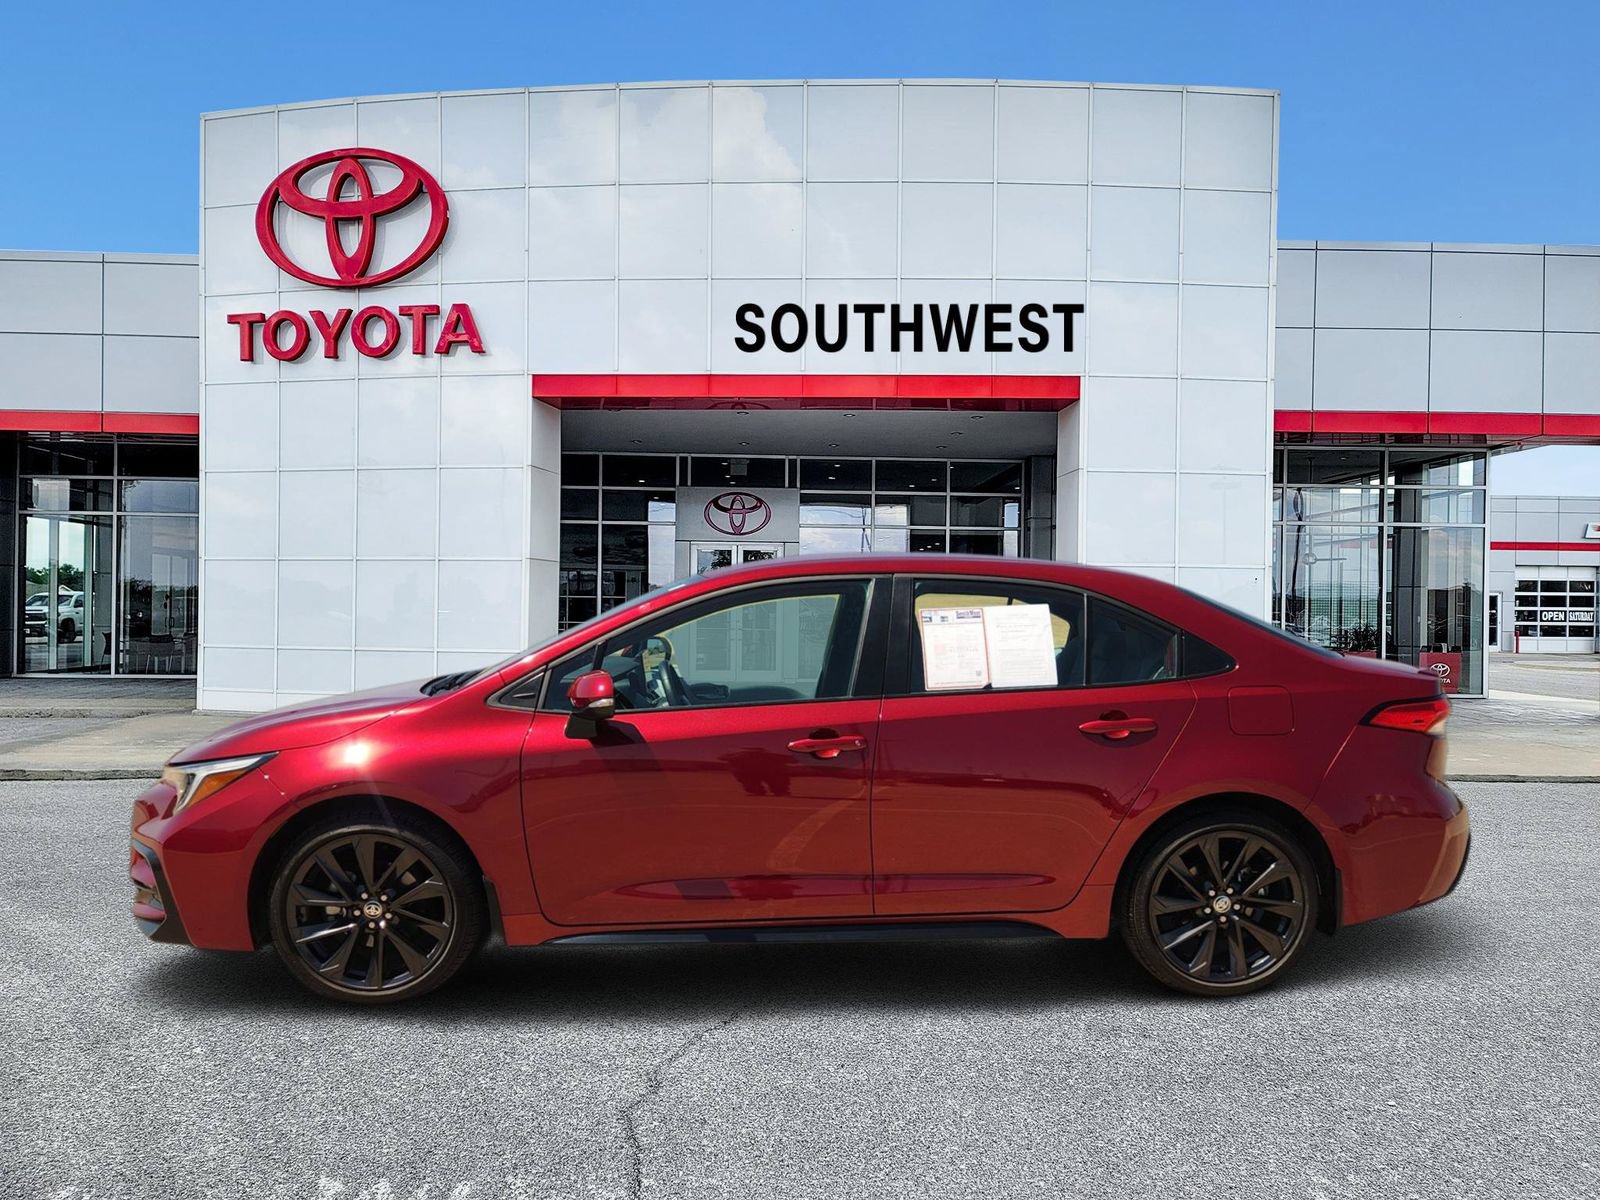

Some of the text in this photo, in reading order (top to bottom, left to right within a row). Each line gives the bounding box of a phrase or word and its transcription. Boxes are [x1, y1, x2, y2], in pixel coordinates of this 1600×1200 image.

[227, 303, 486, 362] TOYOTA
[734, 302, 1085, 353] SOUTHWEST
[1541, 611, 1594, 621] OPEN SATURDAY
